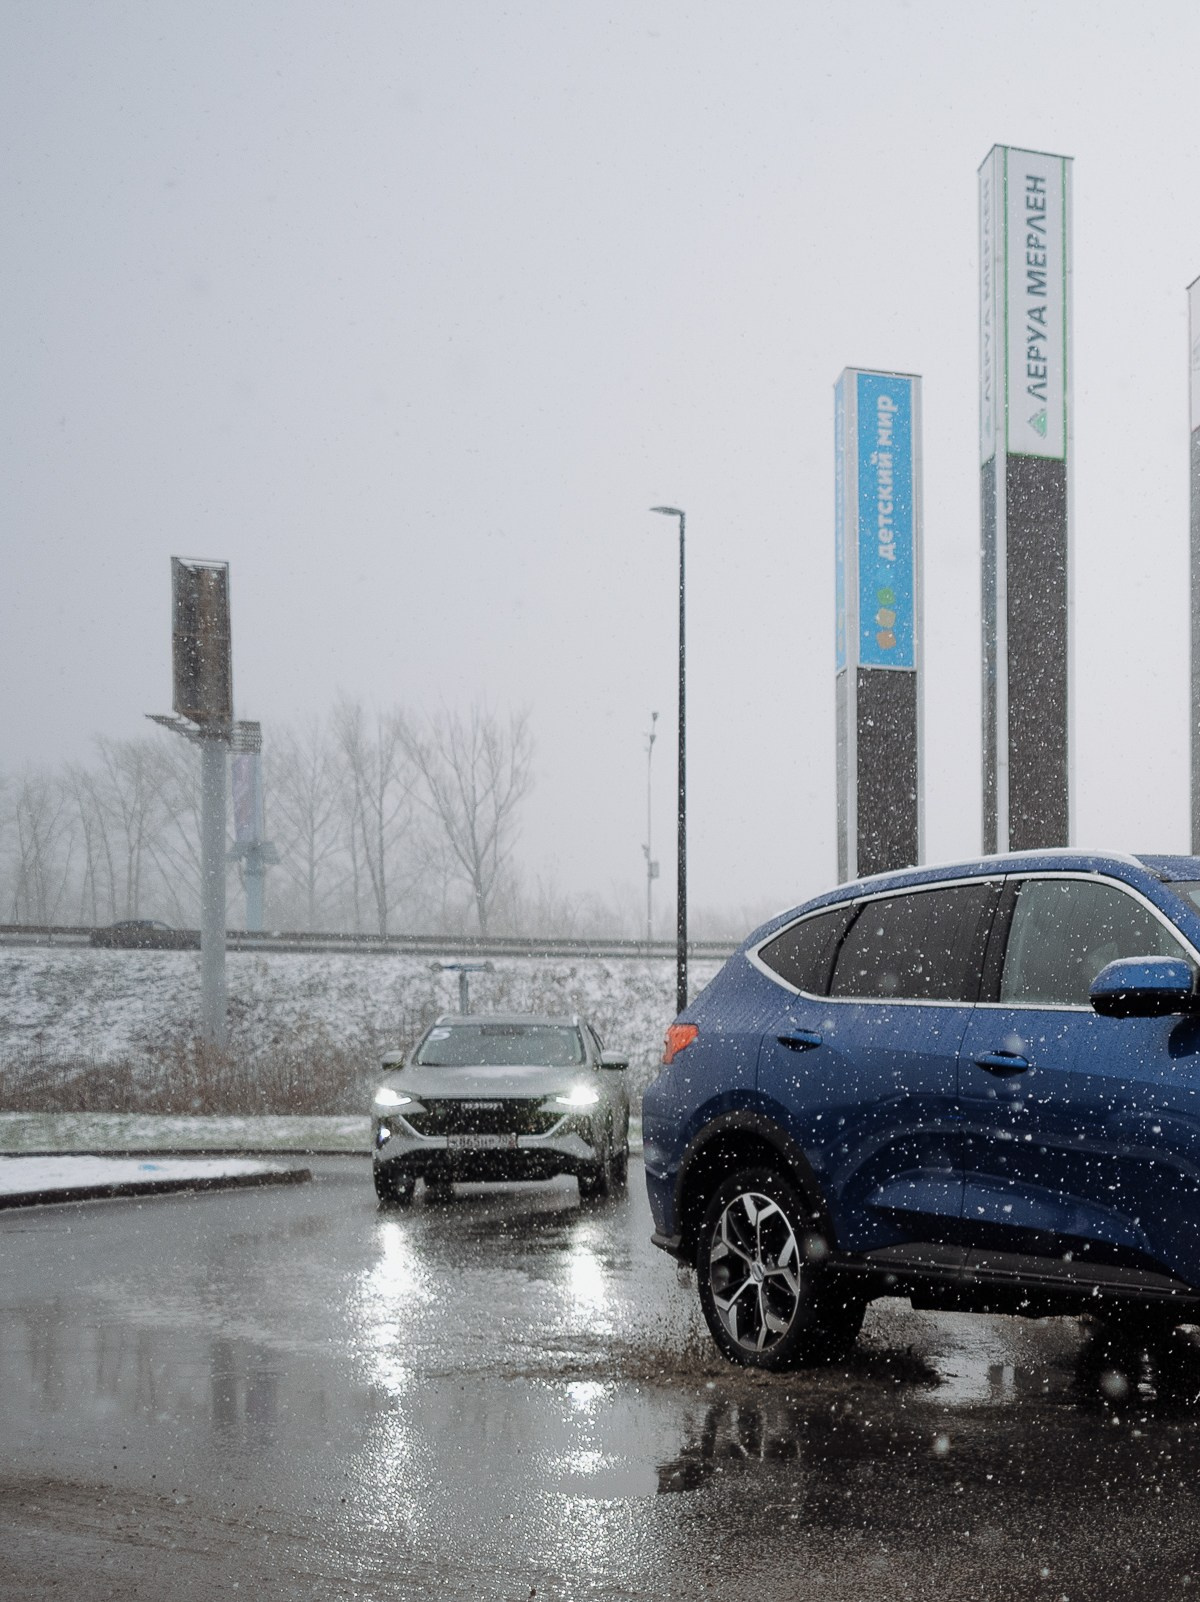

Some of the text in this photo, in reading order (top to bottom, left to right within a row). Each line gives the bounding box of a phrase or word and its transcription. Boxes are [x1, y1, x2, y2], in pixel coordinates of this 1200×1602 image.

[1025, 174, 1048, 402] ЛЕРУА МЕРЛЕН
[870, 394, 899, 561] детский мир
